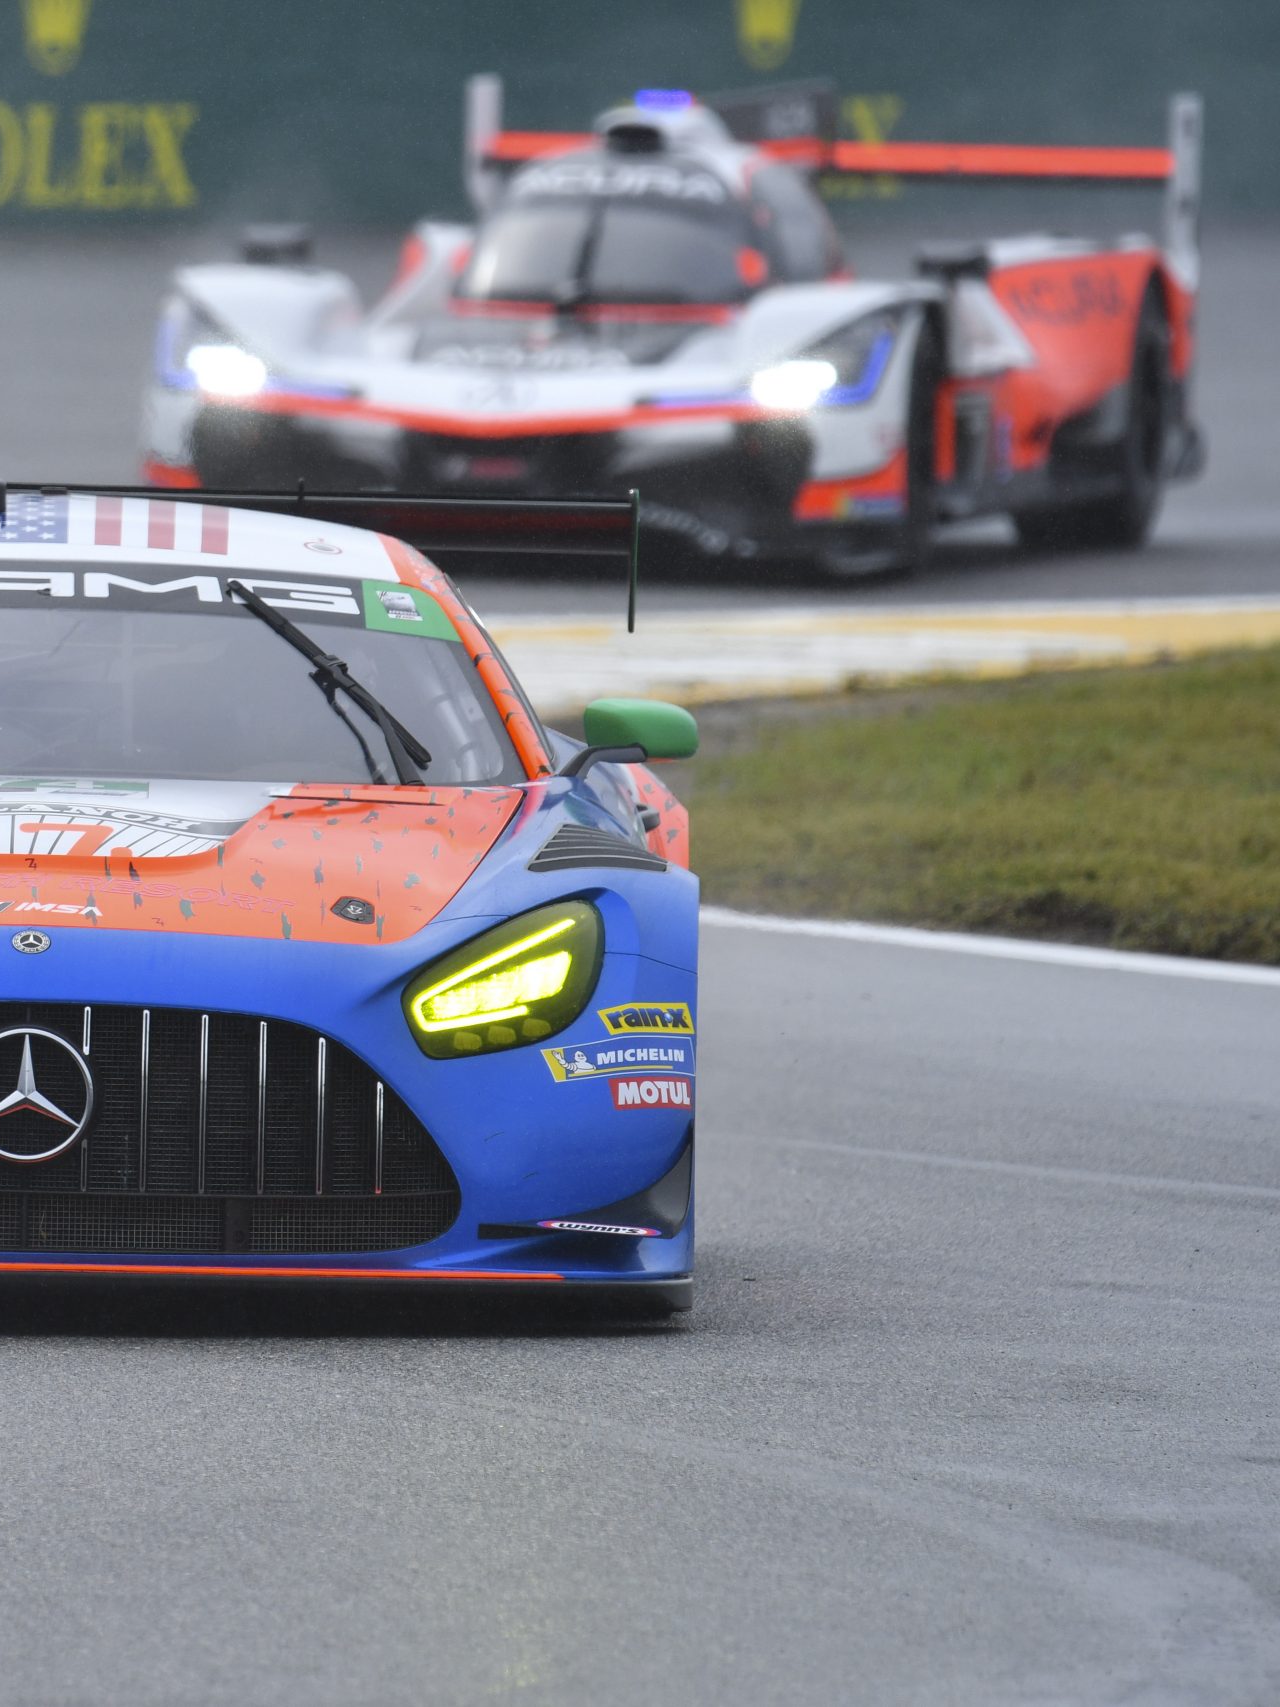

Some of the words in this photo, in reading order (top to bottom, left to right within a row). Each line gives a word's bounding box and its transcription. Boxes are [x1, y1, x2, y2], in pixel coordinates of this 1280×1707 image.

[14, 901, 104, 917] IMSA
[596, 1048, 685, 1066] MICHELIN
[617, 1080, 691, 1106] MOTUL
